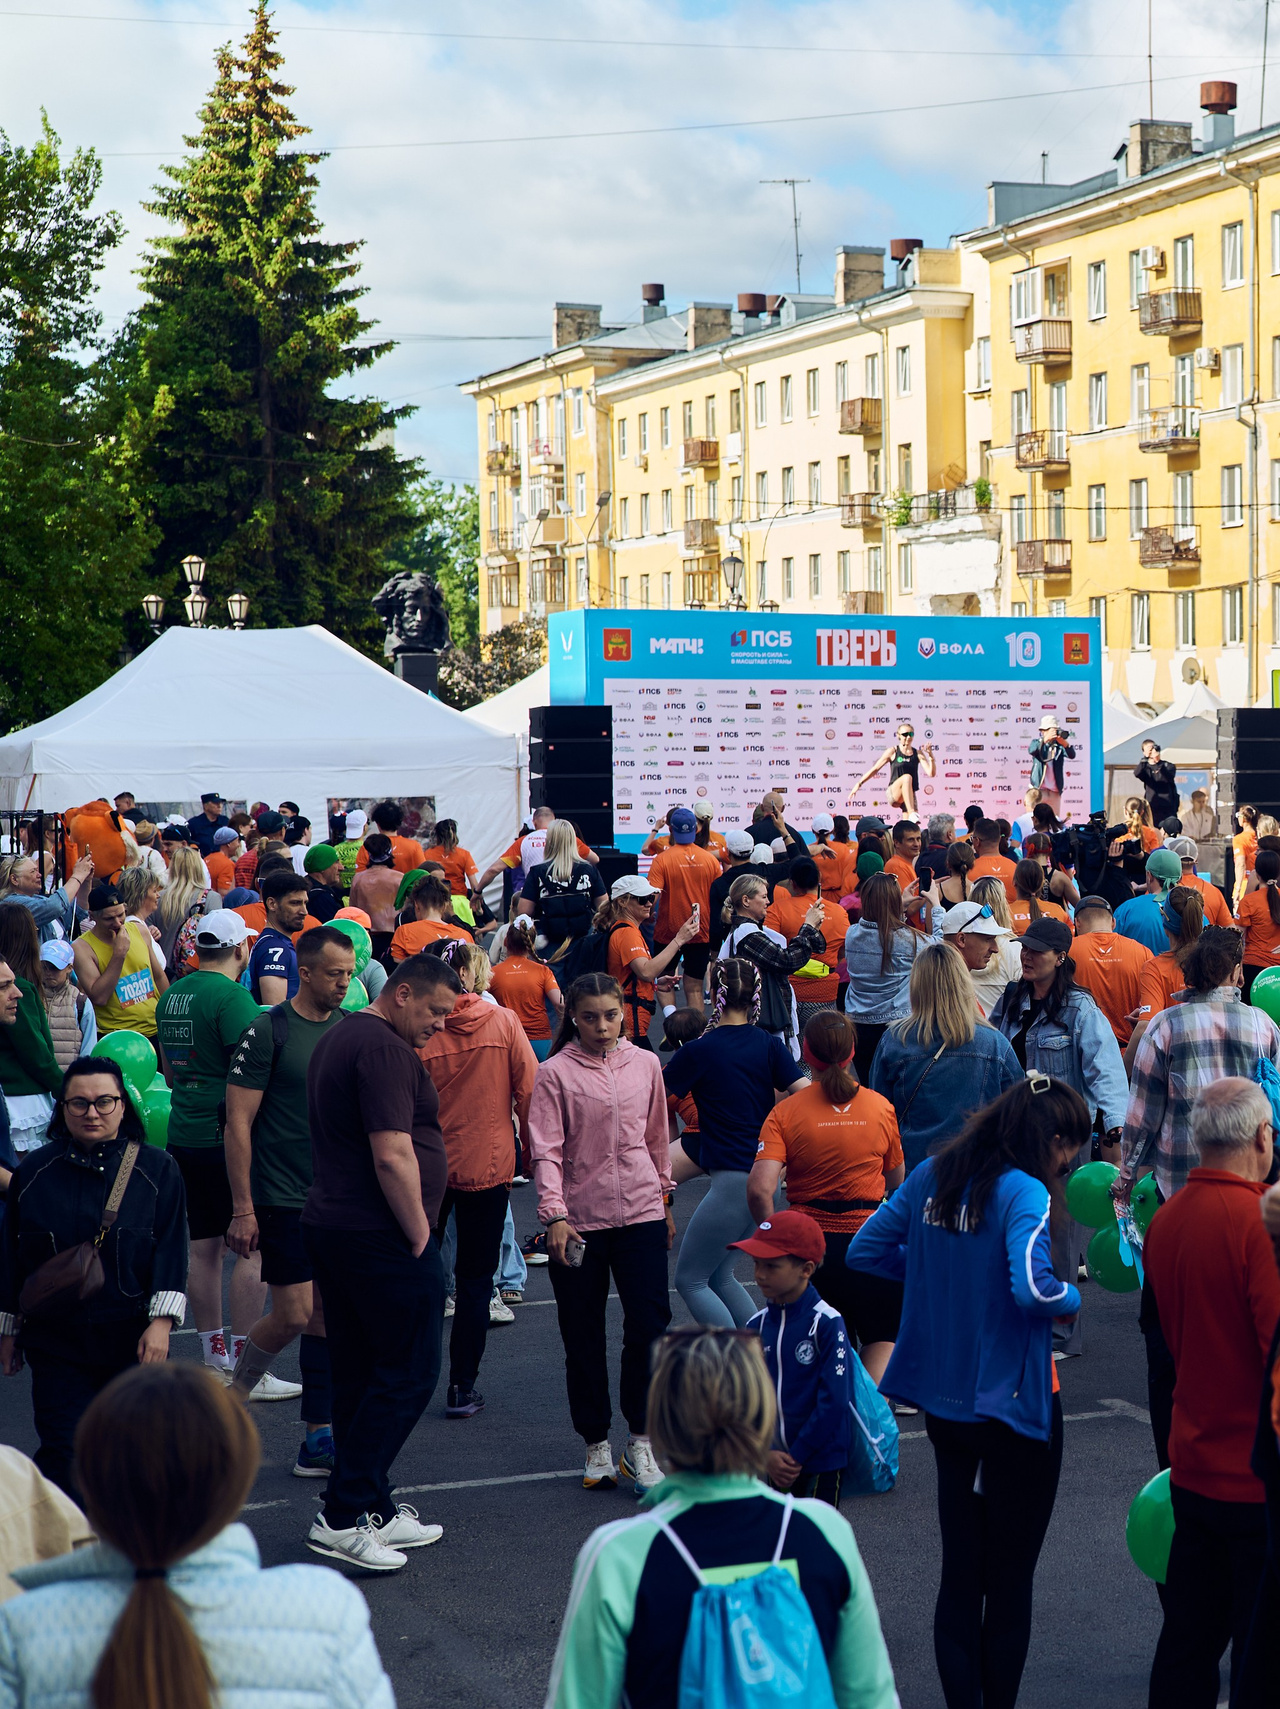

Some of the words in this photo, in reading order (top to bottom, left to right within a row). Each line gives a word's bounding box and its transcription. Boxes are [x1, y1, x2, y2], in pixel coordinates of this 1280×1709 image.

[650, 638, 703, 654] МАТЧ!
[751, 630, 792, 647] ПСБ
[815, 628, 897, 666] ТВЕРЬ
[939, 643, 985, 655] ВФЛА
[1004, 631, 1042, 667] 10
[268, 948, 284, 962] 7
[120, 978, 151, 1000] 70207
